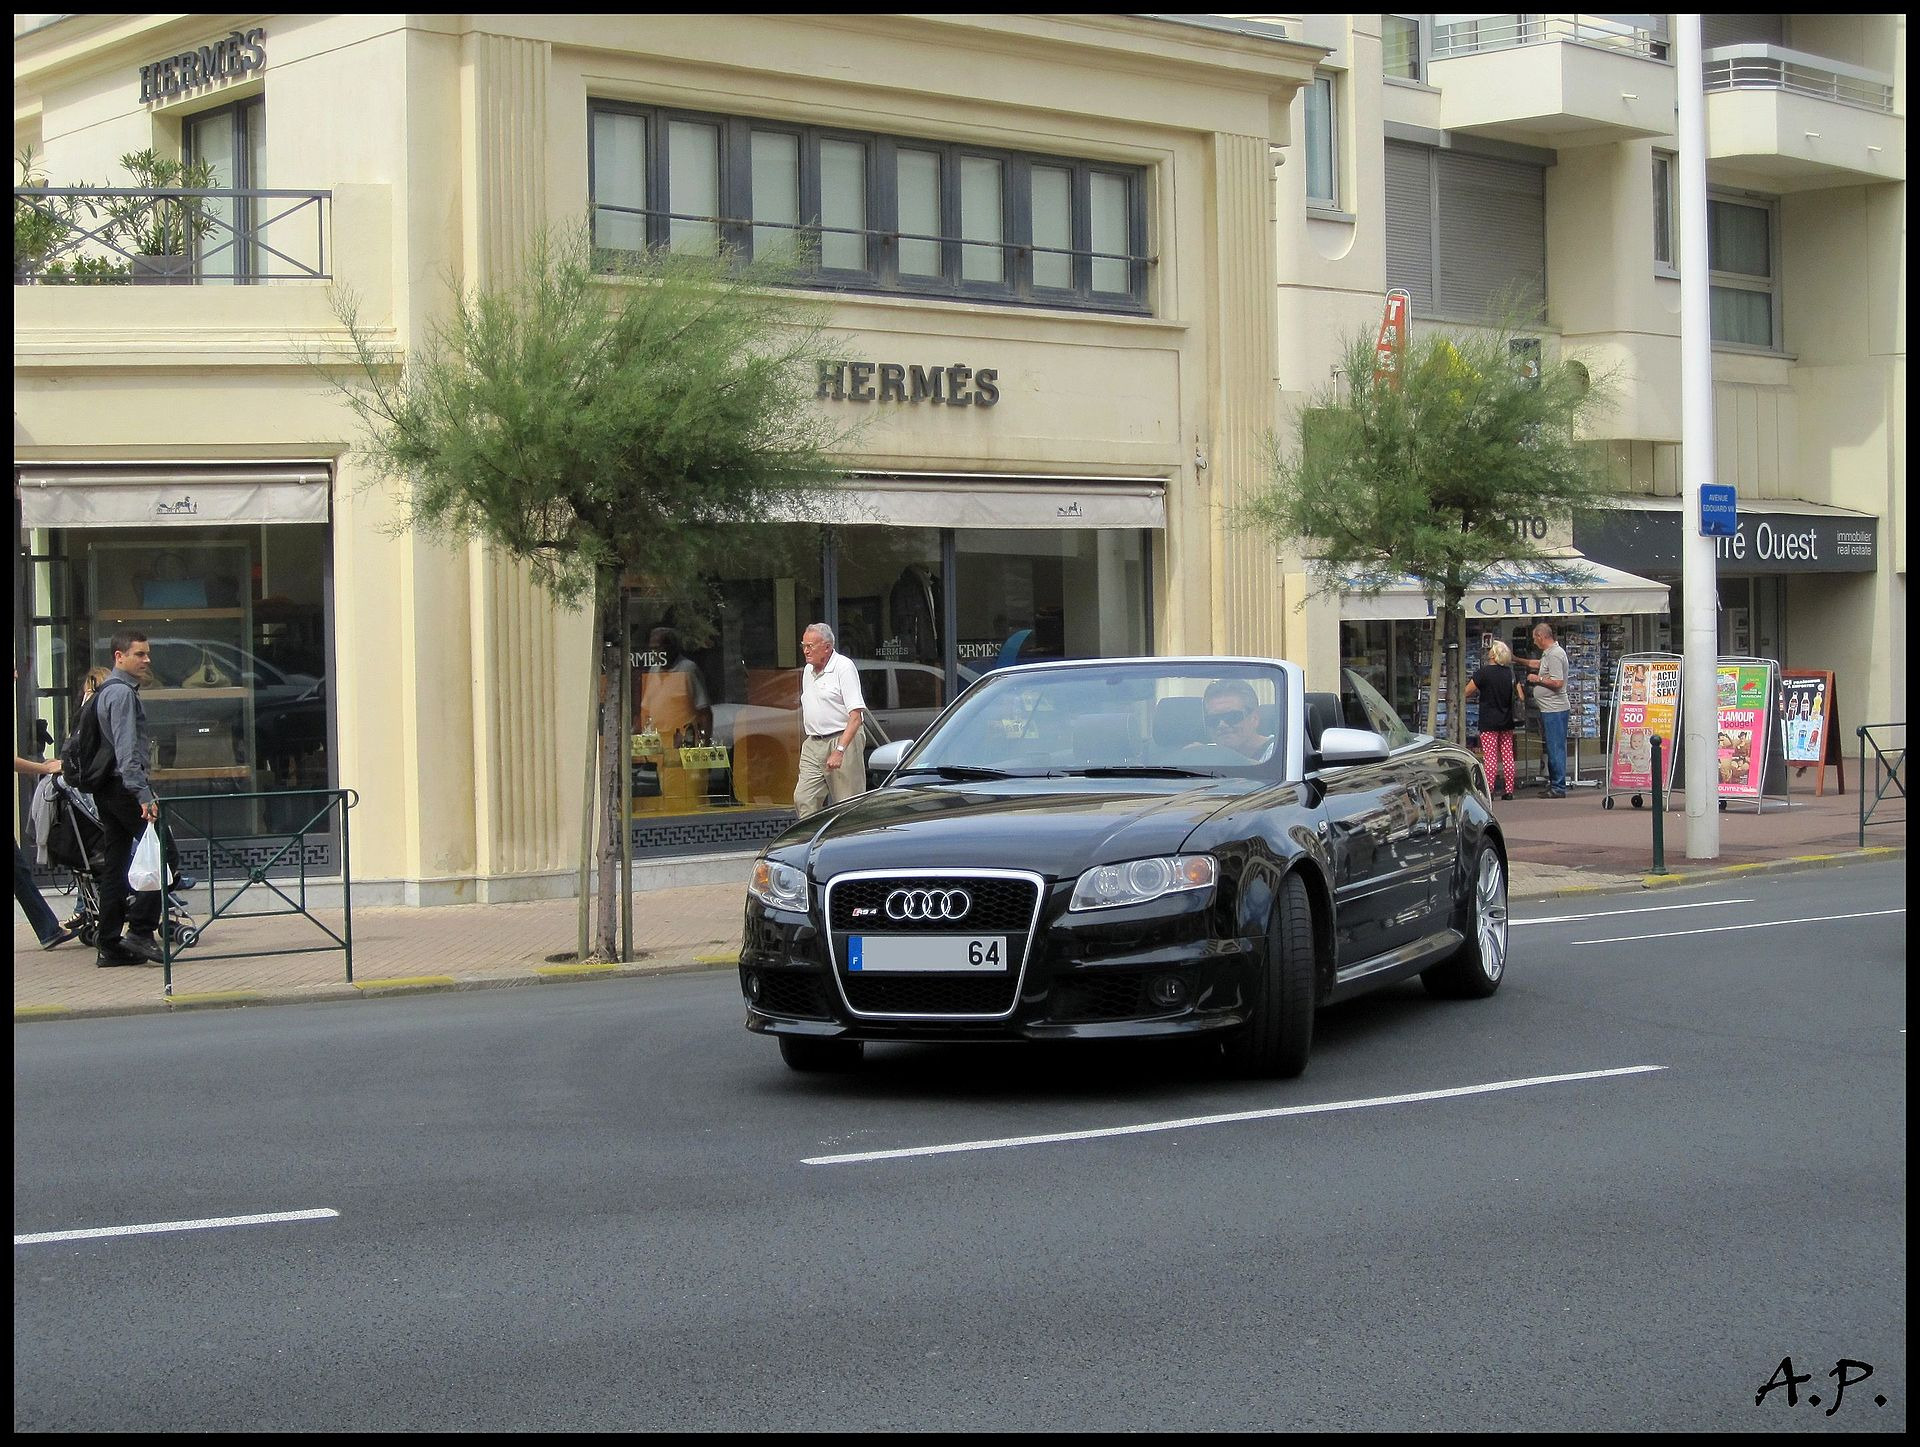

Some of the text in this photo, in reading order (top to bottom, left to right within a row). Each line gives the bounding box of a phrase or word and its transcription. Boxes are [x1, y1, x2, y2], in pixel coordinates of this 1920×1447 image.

[138, 28, 267, 104] HERMÈS
[1708, 494, 1729, 502] AVENUE
[1702, 504, 1727, 513] EDOUARD
[1716, 522, 1818, 560] rré Ouest
[1836, 530, 1872, 542] immobilier
[1837, 545, 1872, 556] real estate
[1474, 595, 1595, 617] CHEIK
[957, 642, 1001, 658] ERMÈS
[629, 650, 668, 667] RMÈS
[1657, 671, 1677, 681] ACTU
[1656, 680, 1678, 689] PHOTO
[1656, 688, 1677, 698] SEXY
[1623, 713, 1644, 723] 500
[1717, 710, 1755, 723] GLAMOUR
[852, 940, 1000, 966] F 64
